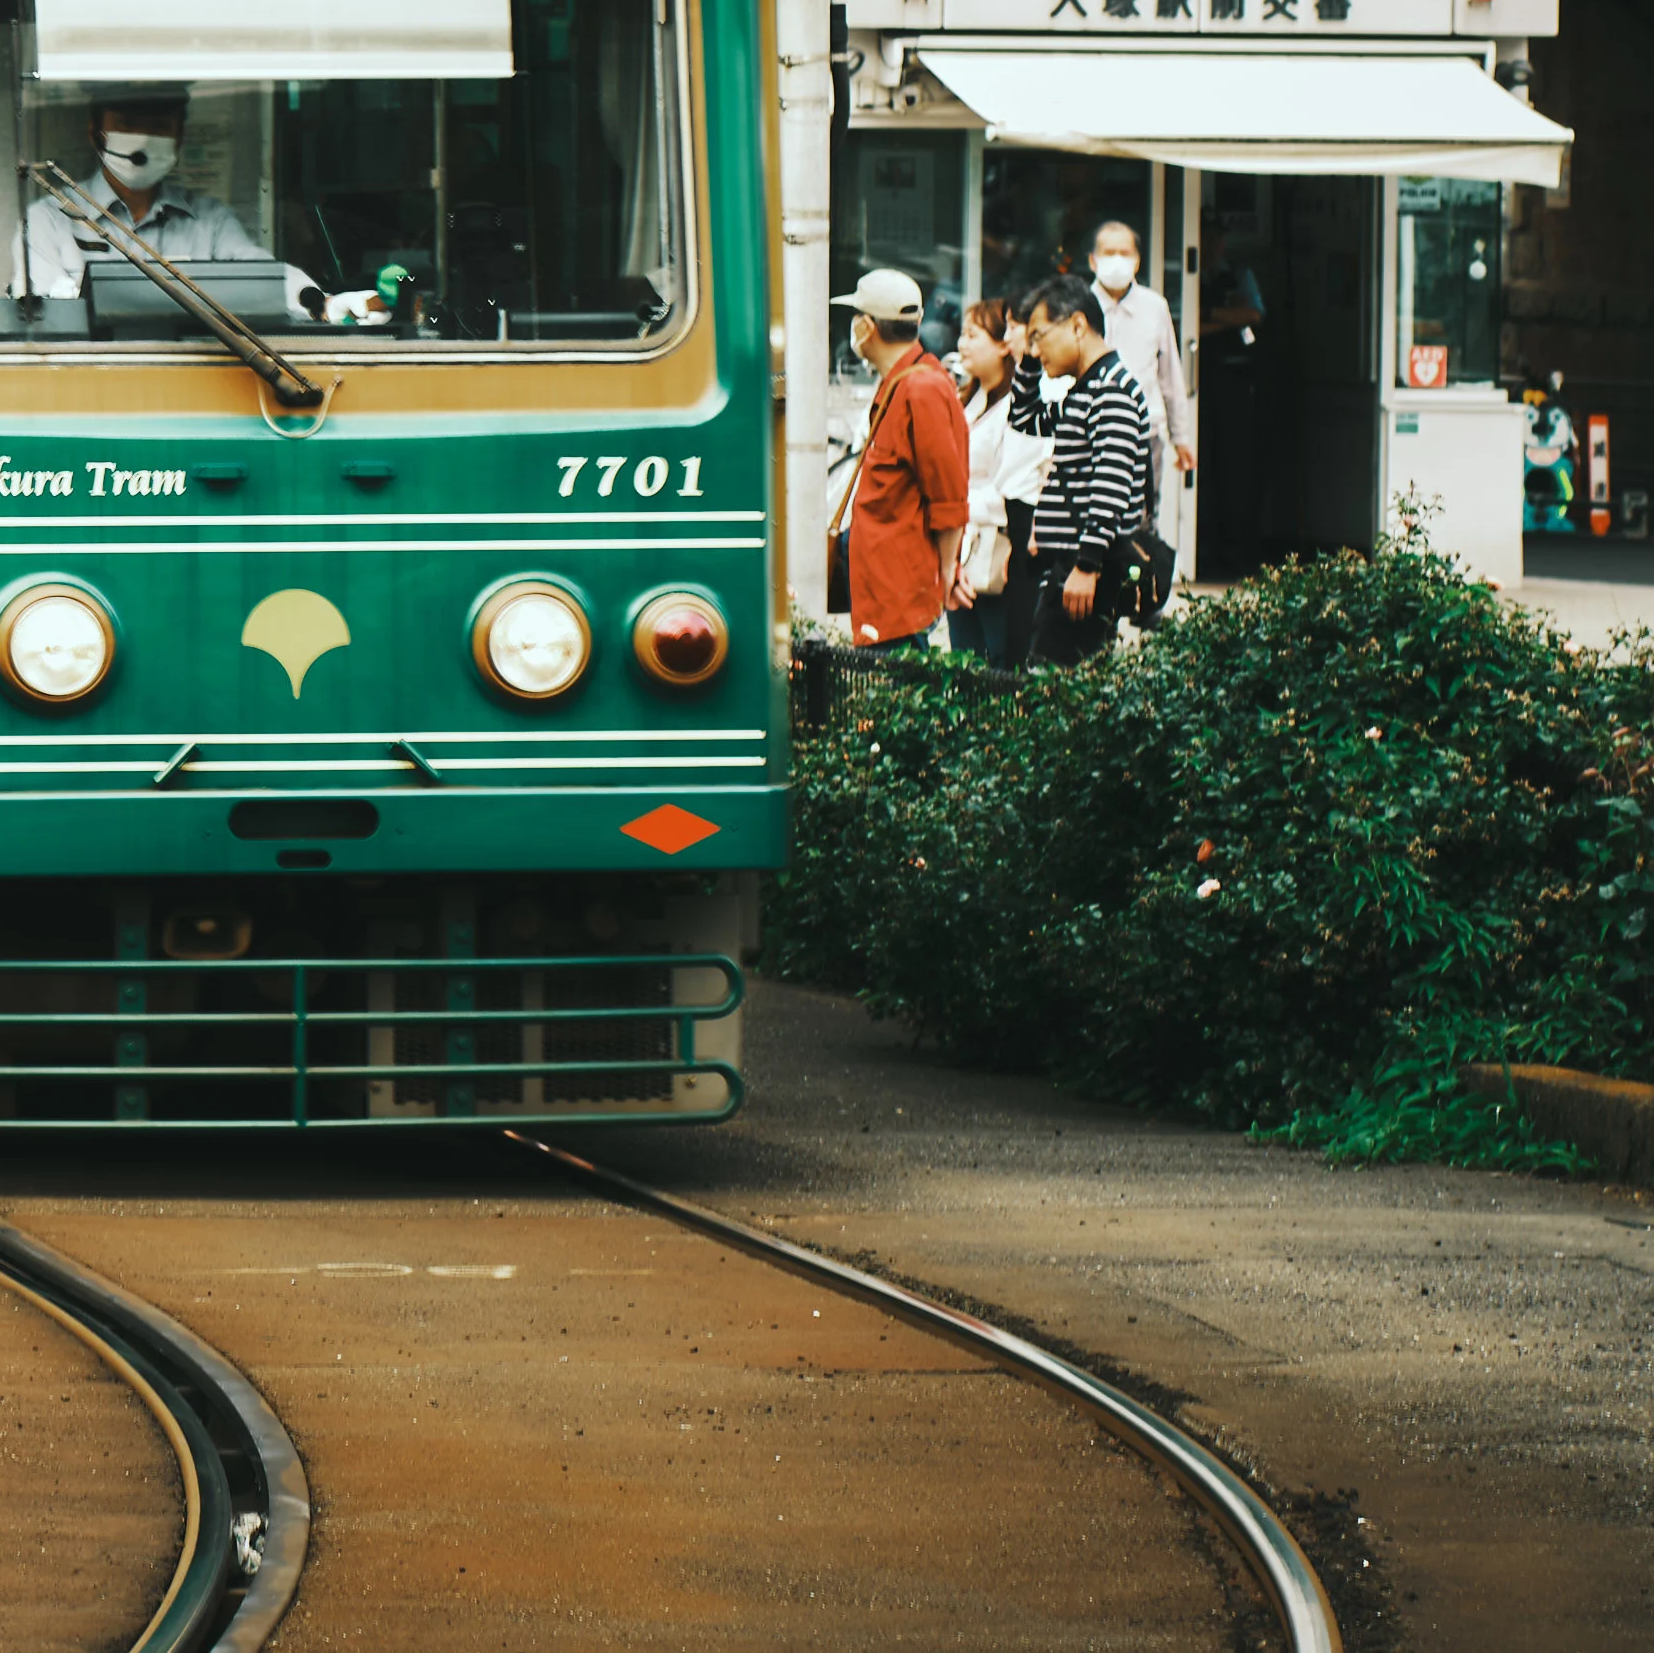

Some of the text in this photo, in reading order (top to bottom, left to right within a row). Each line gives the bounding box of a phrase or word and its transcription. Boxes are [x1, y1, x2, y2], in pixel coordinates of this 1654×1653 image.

[1411, 347, 1443, 362] AED
[84, 460, 188, 498] Tram
[556, 455, 705, 498] 7701
